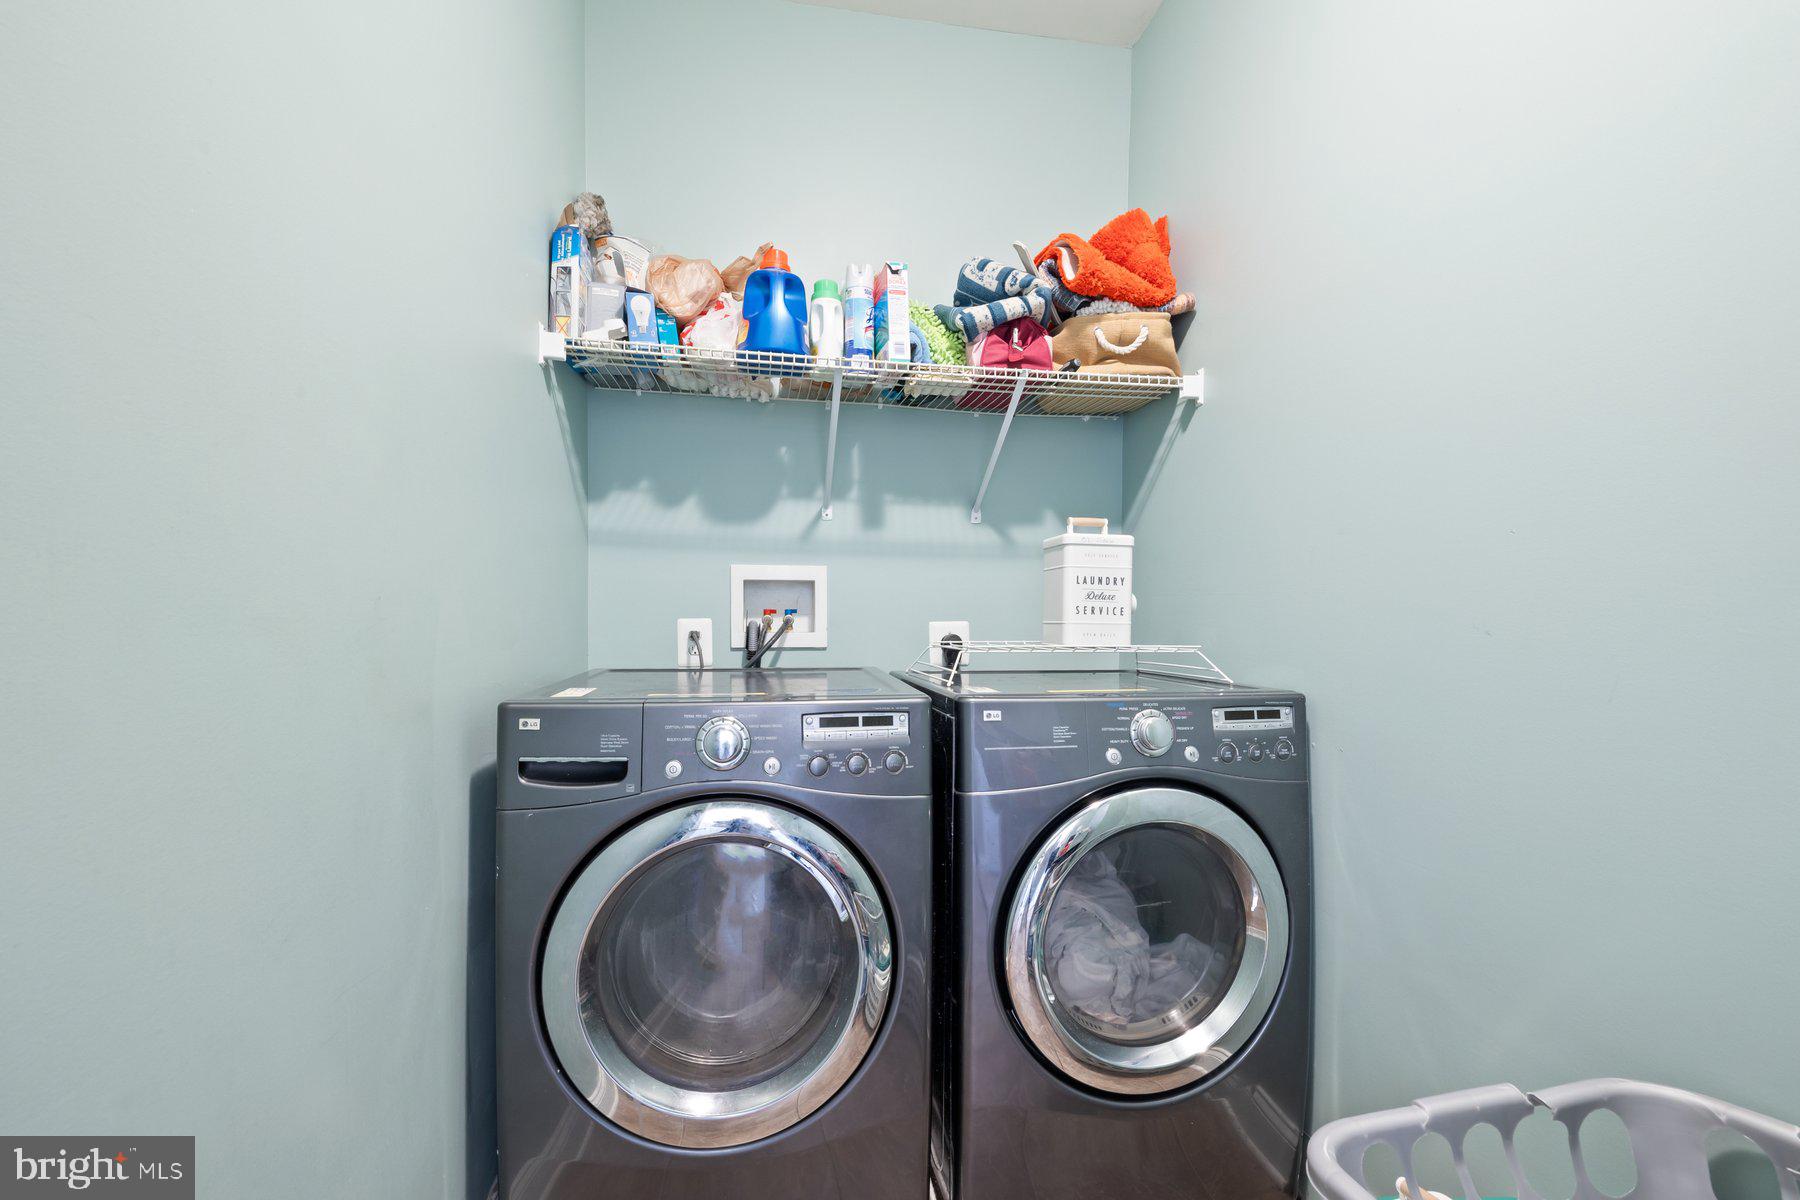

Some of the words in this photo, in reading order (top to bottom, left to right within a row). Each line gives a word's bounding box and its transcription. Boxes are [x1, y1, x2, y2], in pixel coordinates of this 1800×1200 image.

[1076, 575, 1126, 587] LAUNDRY
[1084, 591, 1117, 602] Deluxe
[1075, 605, 1125, 617] SERVICE
